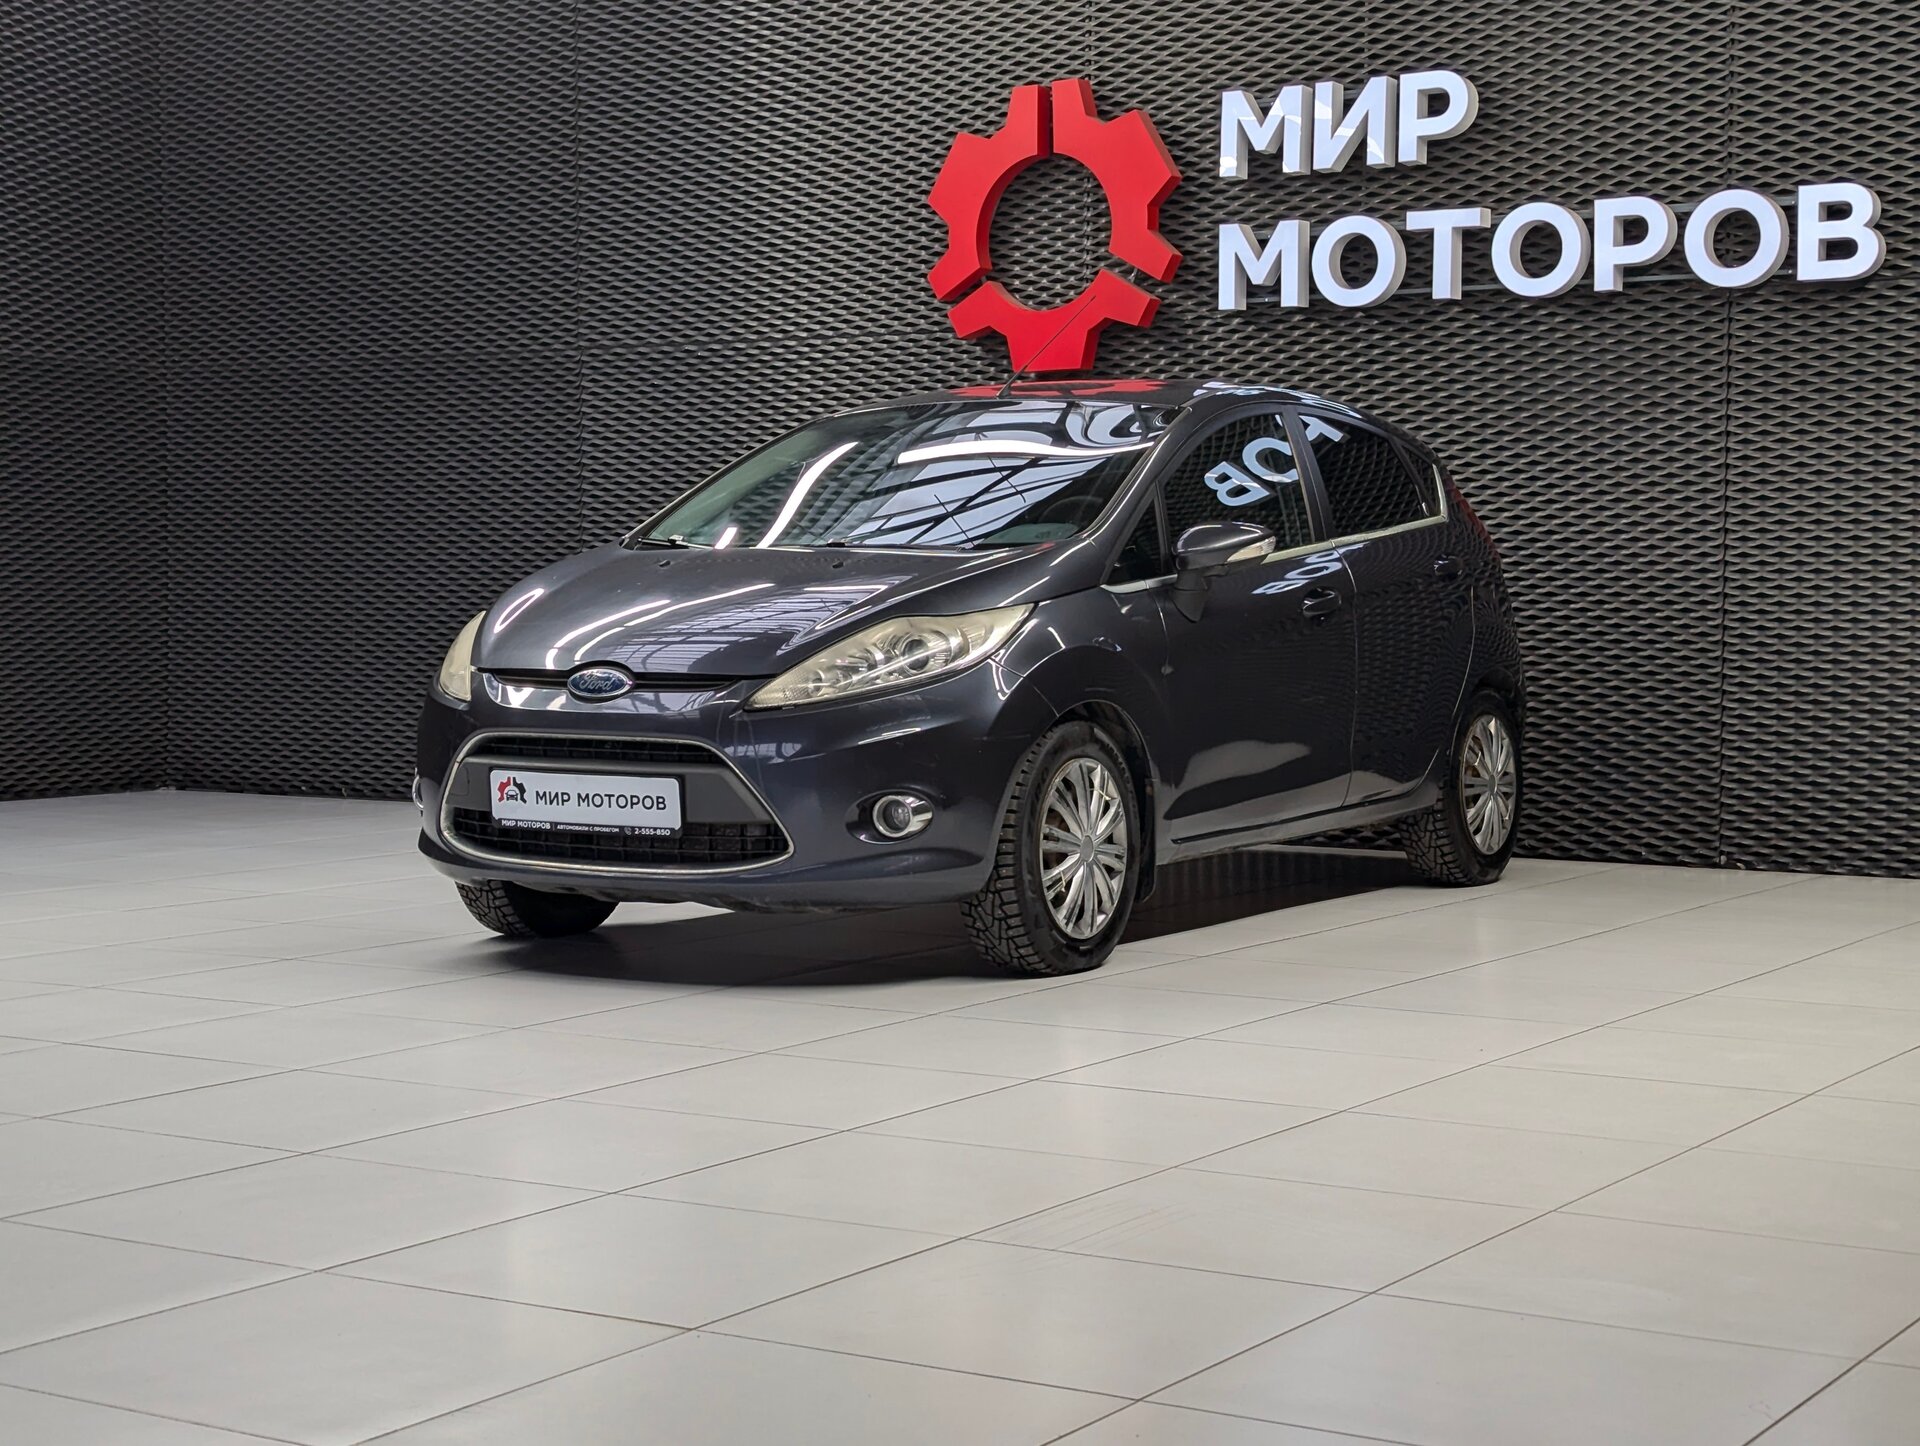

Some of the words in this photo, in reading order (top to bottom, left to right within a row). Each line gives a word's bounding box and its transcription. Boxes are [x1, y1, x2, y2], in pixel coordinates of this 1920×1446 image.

[1218, 69, 1479, 179] МИР
[1217, 182, 1887, 311] МОТОРОВ
[578, 671, 617, 691] Ford
[535, 790, 571, 806] МИР
[577, 792, 667, 811] МОТОРОВ
[501, 819, 516, 827] МИР
[517, 820, 551, 830] МОТОРОВ
[634, 827, 671, 836] 2-555-850
